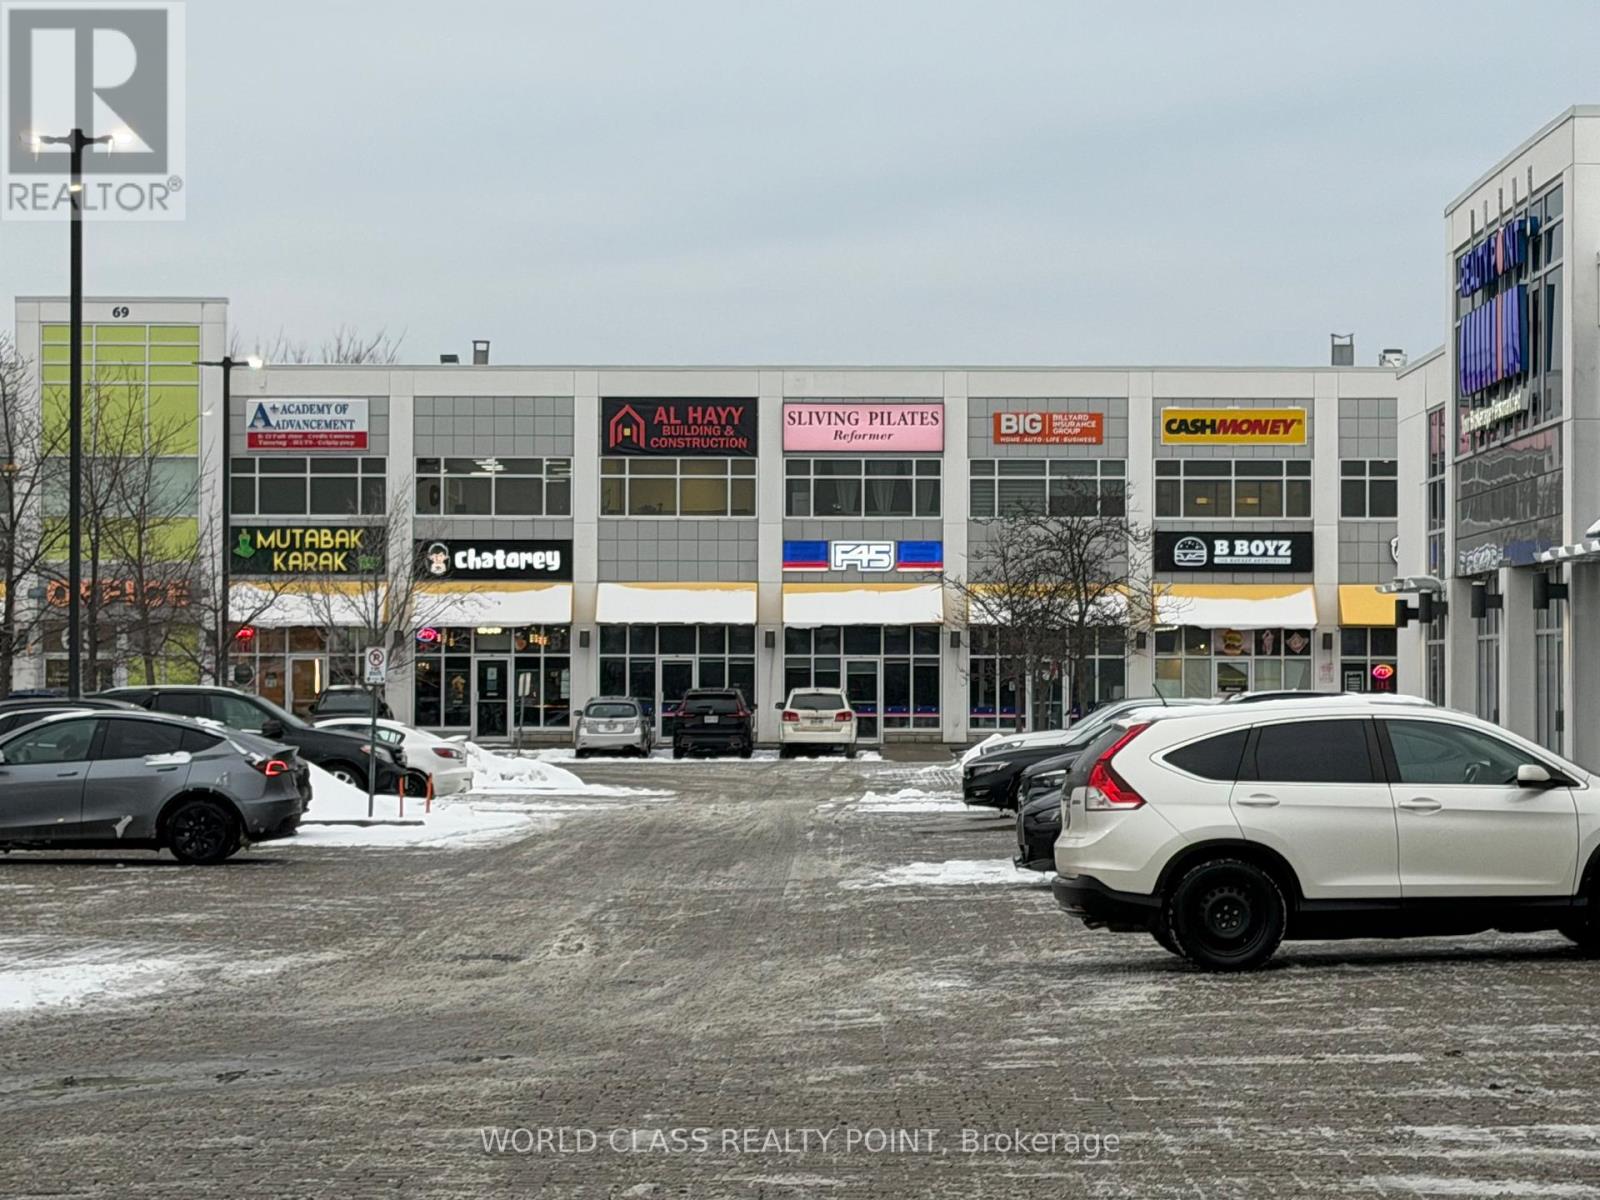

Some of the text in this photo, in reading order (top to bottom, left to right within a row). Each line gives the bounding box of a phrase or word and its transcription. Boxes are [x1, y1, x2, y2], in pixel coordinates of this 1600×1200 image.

[112, 306, 130, 319] 69
[280, 403, 333, 415] ACADEMY
[334, 403, 349, 415] OF
[653, 406, 744, 424] AL HAYY
[273, 419, 356, 430] ADVANCEMENT
[787, 411, 940, 426] SLIVING PILATES
[1000, 414, 1042, 434] BIG
[662, 425, 735, 436] BUILDING &
[833, 430, 894, 443] Reformer
[650, 437, 748, 448] CONSTRUCTION
[256, 528, 364, 549] MUTABAK
[1213, 540, 1291, 555] B BOYZ
[273, 551, 348, 571] KARAK
[833, 542, 892, 569] F45
